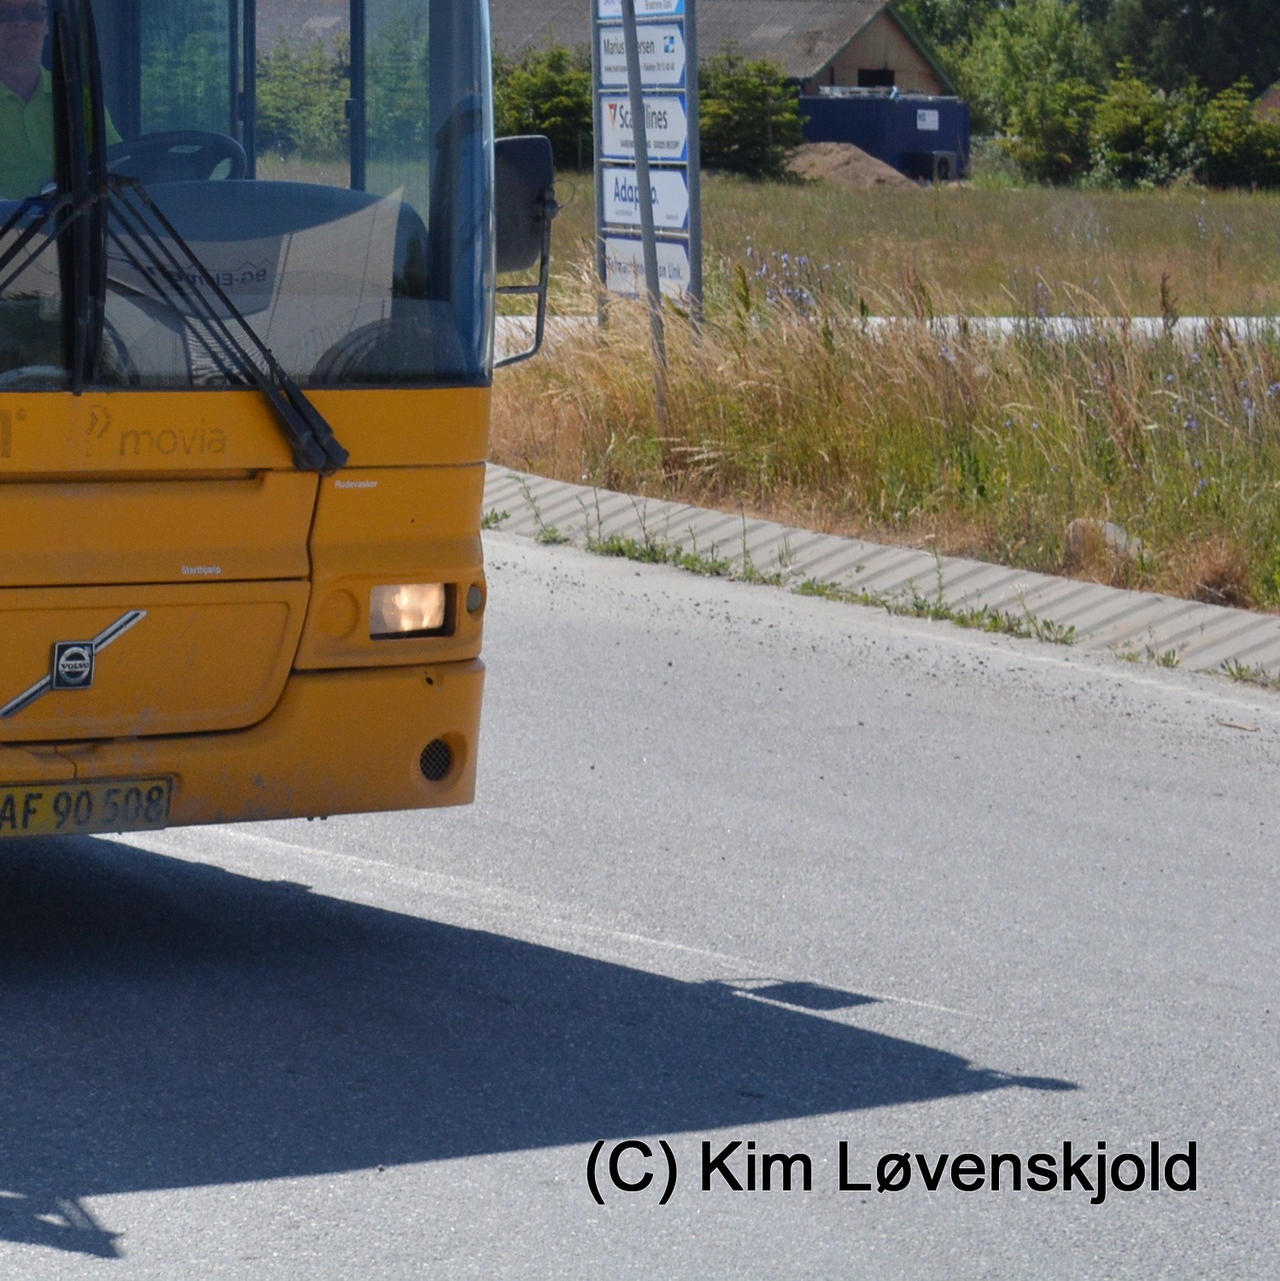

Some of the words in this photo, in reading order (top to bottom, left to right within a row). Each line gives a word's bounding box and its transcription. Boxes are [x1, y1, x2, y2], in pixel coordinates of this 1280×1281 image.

[603, 37, 624, 55] Marius
[619, 103, 668, 130] Scalines
[614, 176, 659, 211] Adapo.
[119, 419, 227, 457] movia
[61, 662, 90, 671] VOLVO
[53, 790, 93, 829] 90
[100, 785, 164, 824] 508
